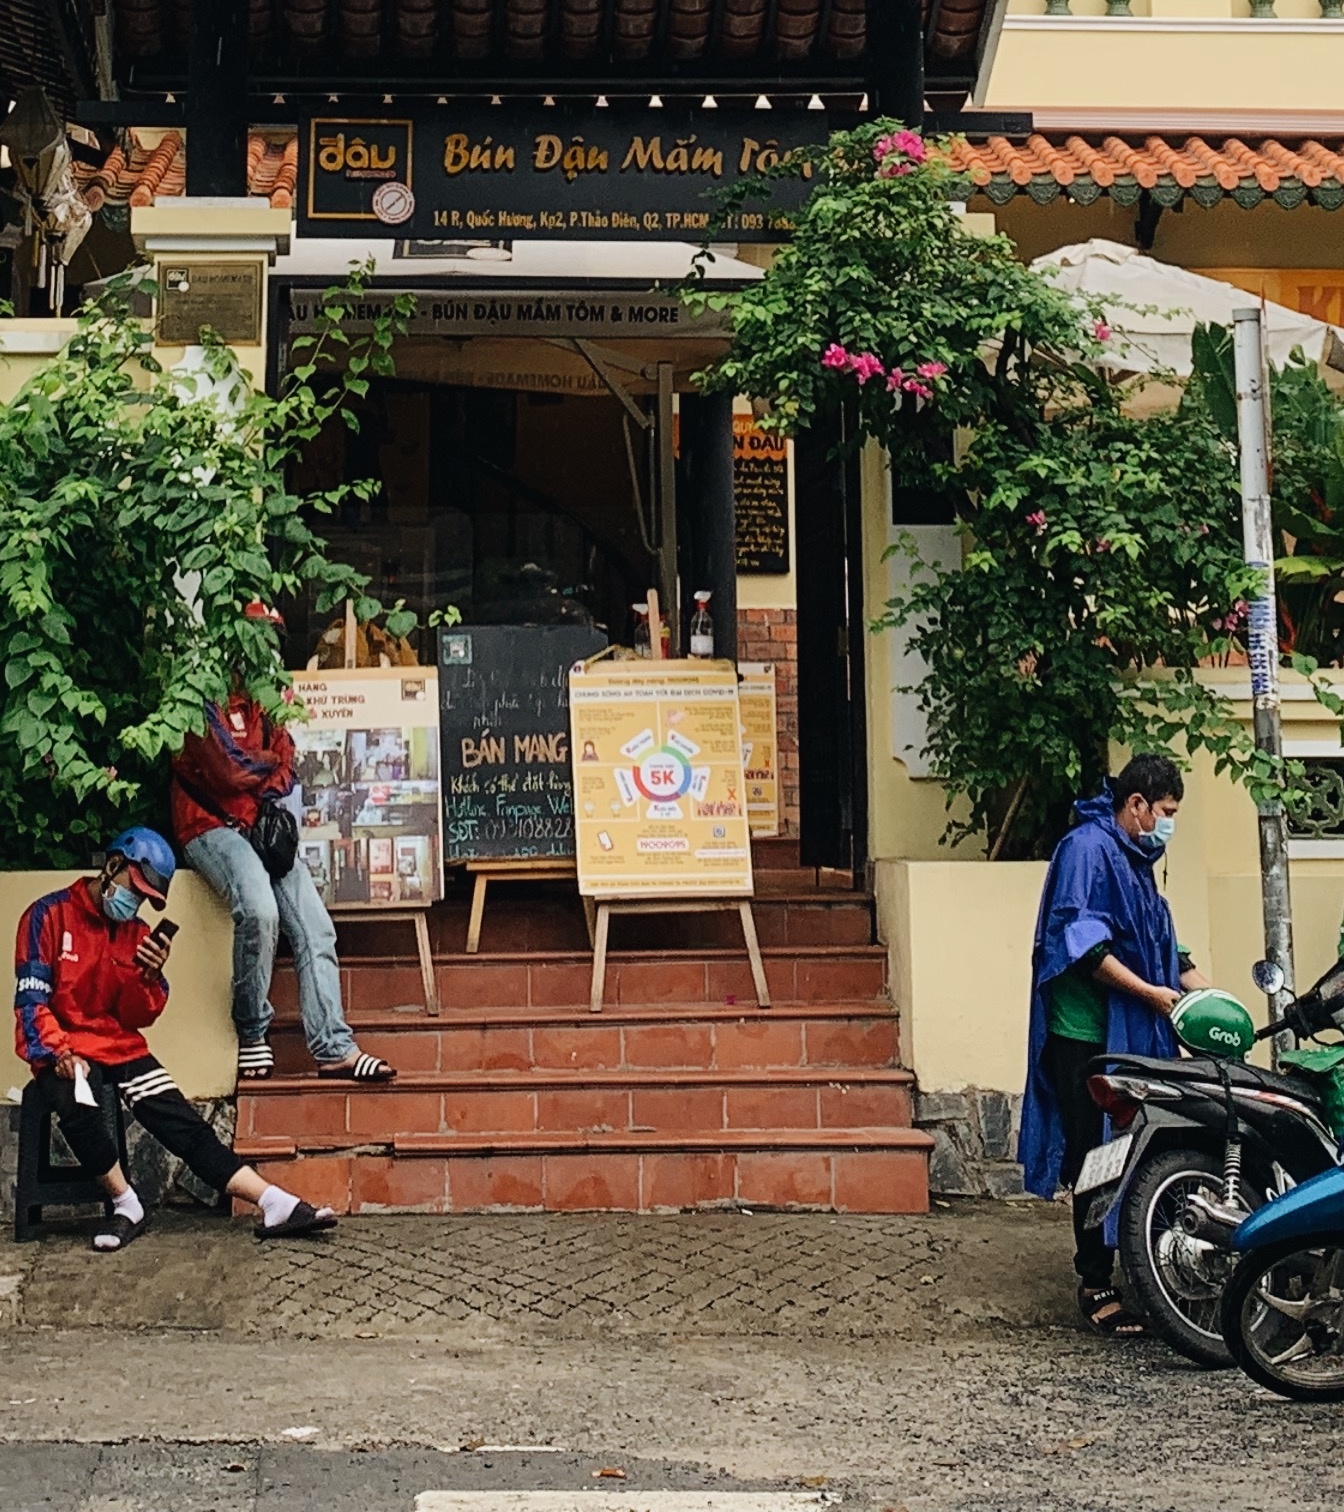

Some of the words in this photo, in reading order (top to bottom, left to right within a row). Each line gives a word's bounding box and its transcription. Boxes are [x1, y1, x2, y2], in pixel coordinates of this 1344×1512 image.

[444, 133, 515, 175] Bún
[533, 135, 608, 180] Đậu
[621, 134, 723, 176] Mắm
[433, 211, 448, 227] 14
[466, 209, 494, 228] Quốc
[741, 214, 763, 230] 093
[433, 299, 468, 321] BÚN
[474, 300, 511, 325] ĐẬU
[517, 297, 561, 321] MẮM
[566, 301, 604, 322] TÔM
[610, 306, 623, 322] &
[629, 306, 679, 323] MORE
[461, 728, 505, 768] BÁN
[514, 732, 568, 764] MANG
[650, 770, 675, 786] 5K
[1208, 1026, 1242, 1047] Grab
